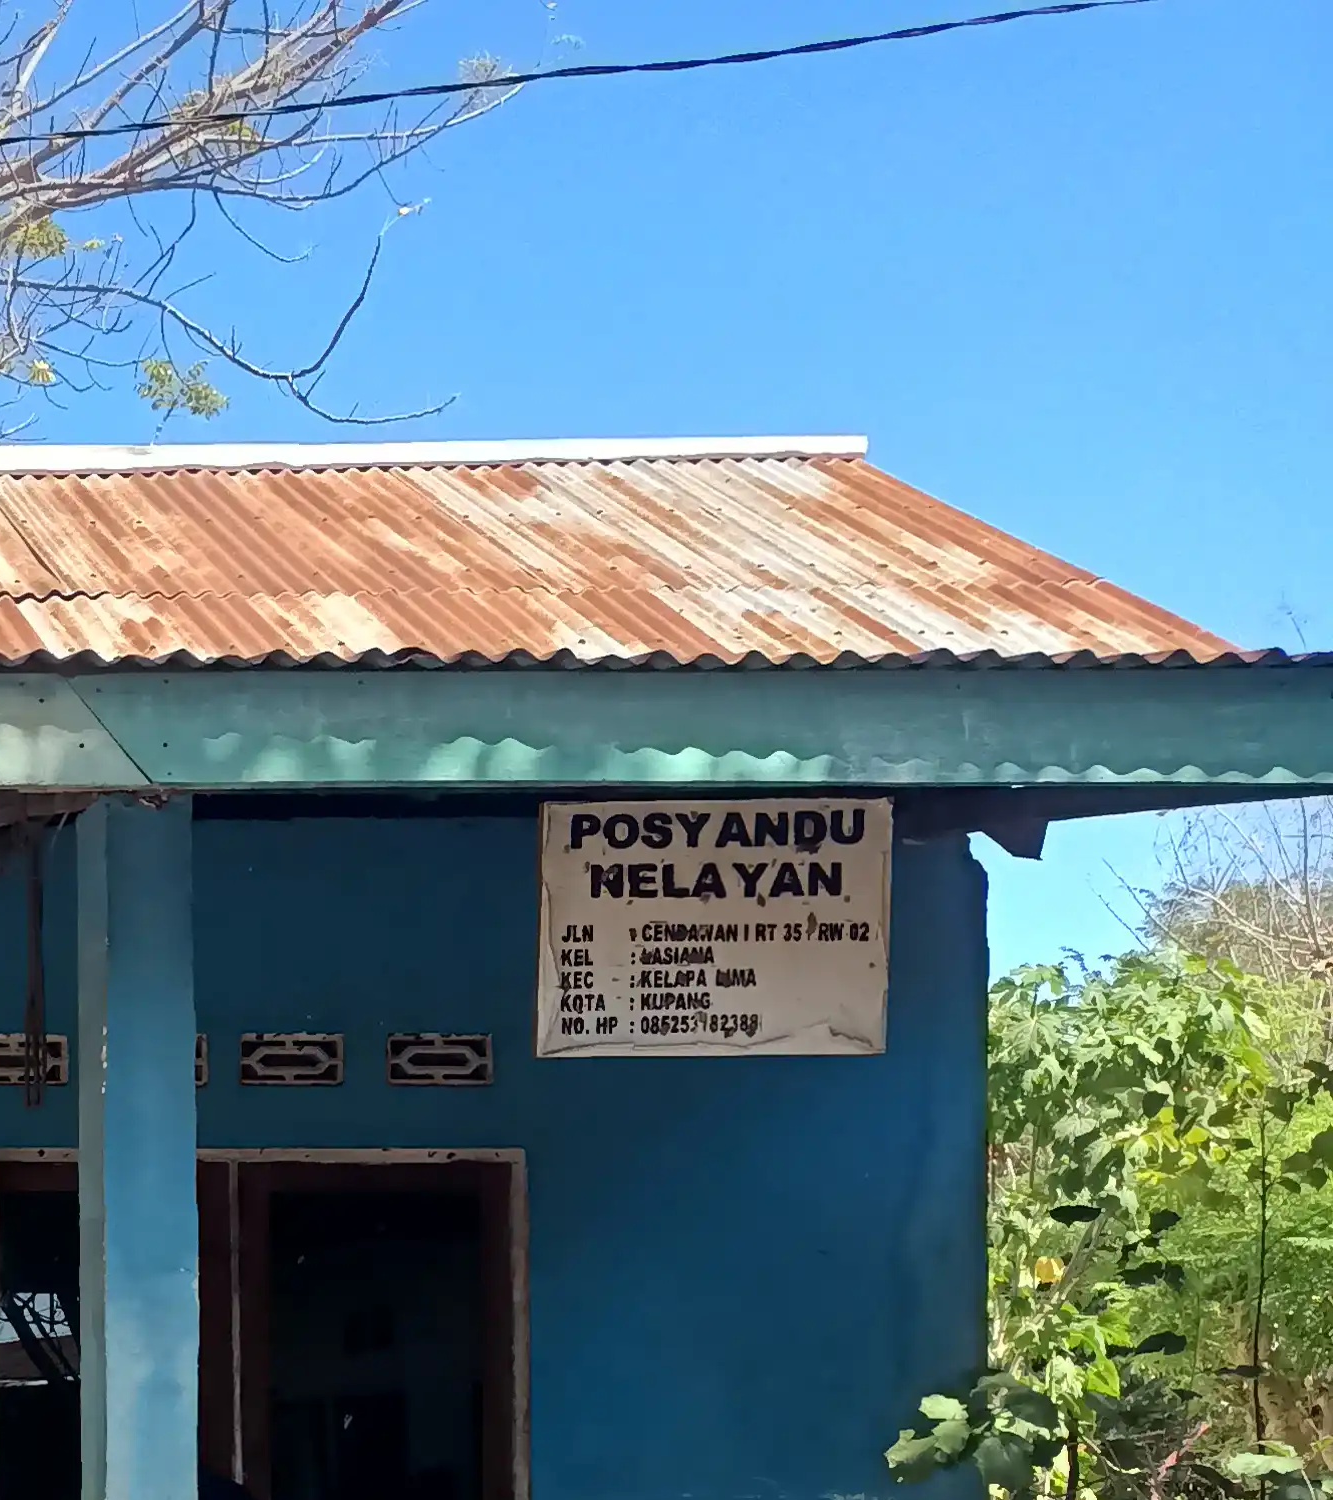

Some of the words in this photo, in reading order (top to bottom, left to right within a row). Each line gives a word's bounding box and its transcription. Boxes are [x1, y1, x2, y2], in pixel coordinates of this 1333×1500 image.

[570, 808, 865, 849] POSYANDU
[589, 861, 843, 899] NELAYAN
[561, 924, 594, 943] JLN
[755, 922, 778, 942] RT
[783, 922, 803, 942] 35
[818, 922, 845, 941] RW
[849, 921, 870, 941] 02
[561, 948, 594, 967] KEL
[560, 970, 594, 989] KEC
[640, 968, 708, 989] KELAPA
[560, 993, 606, 1012] KOTA
[640, 991, 711, 1011] KUPANG
[561, 1016, 590, 1036] NO.
[595, 1015, 619, 1035] HP
